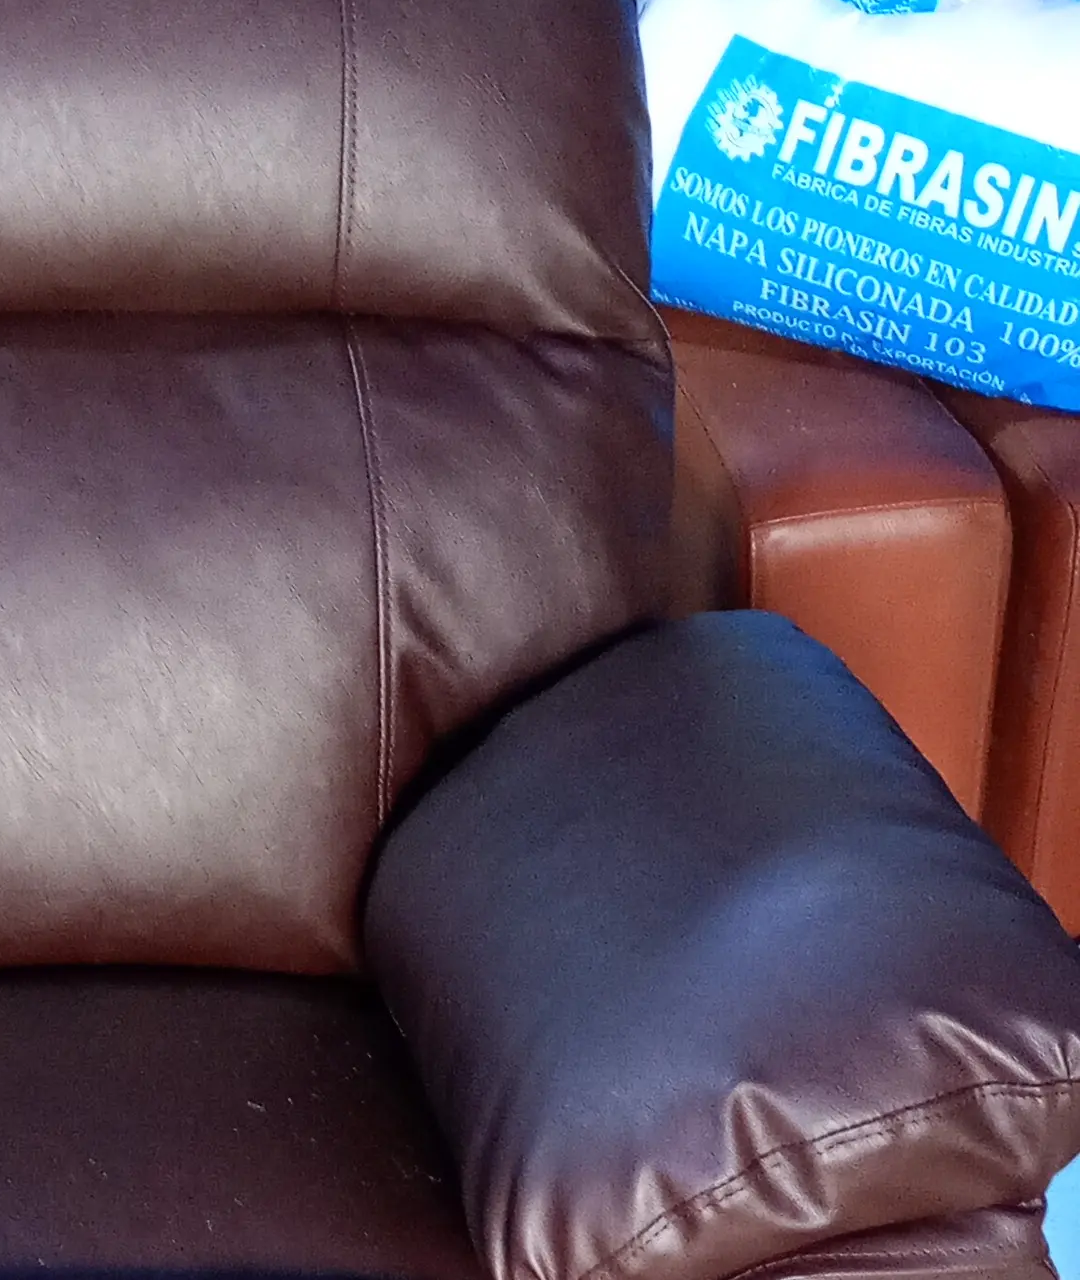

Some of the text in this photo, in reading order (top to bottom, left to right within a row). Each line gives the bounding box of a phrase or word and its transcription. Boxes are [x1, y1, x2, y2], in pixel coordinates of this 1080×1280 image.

[670, 166, 1079, 326] SOMOS LOS PIONEROS EN CALIDAD
[771, 163, 859, 207] FÁBRICA
[863, 194, 894, 217] DE
[897, 204, 974, 244] FIBRAS
[683, 210, 769, 269] NAPA
[777, 246, 974, 334] SILICONADA
[999, 321, 1080, 368] 100%
[759, 277, 912, 345] FIBRASIN
[924, 331, 987, 365] 103
[733, 300, 836, 339] PRODUCTO
[872, 340, 1006, 392] EXPORTACIÓN
